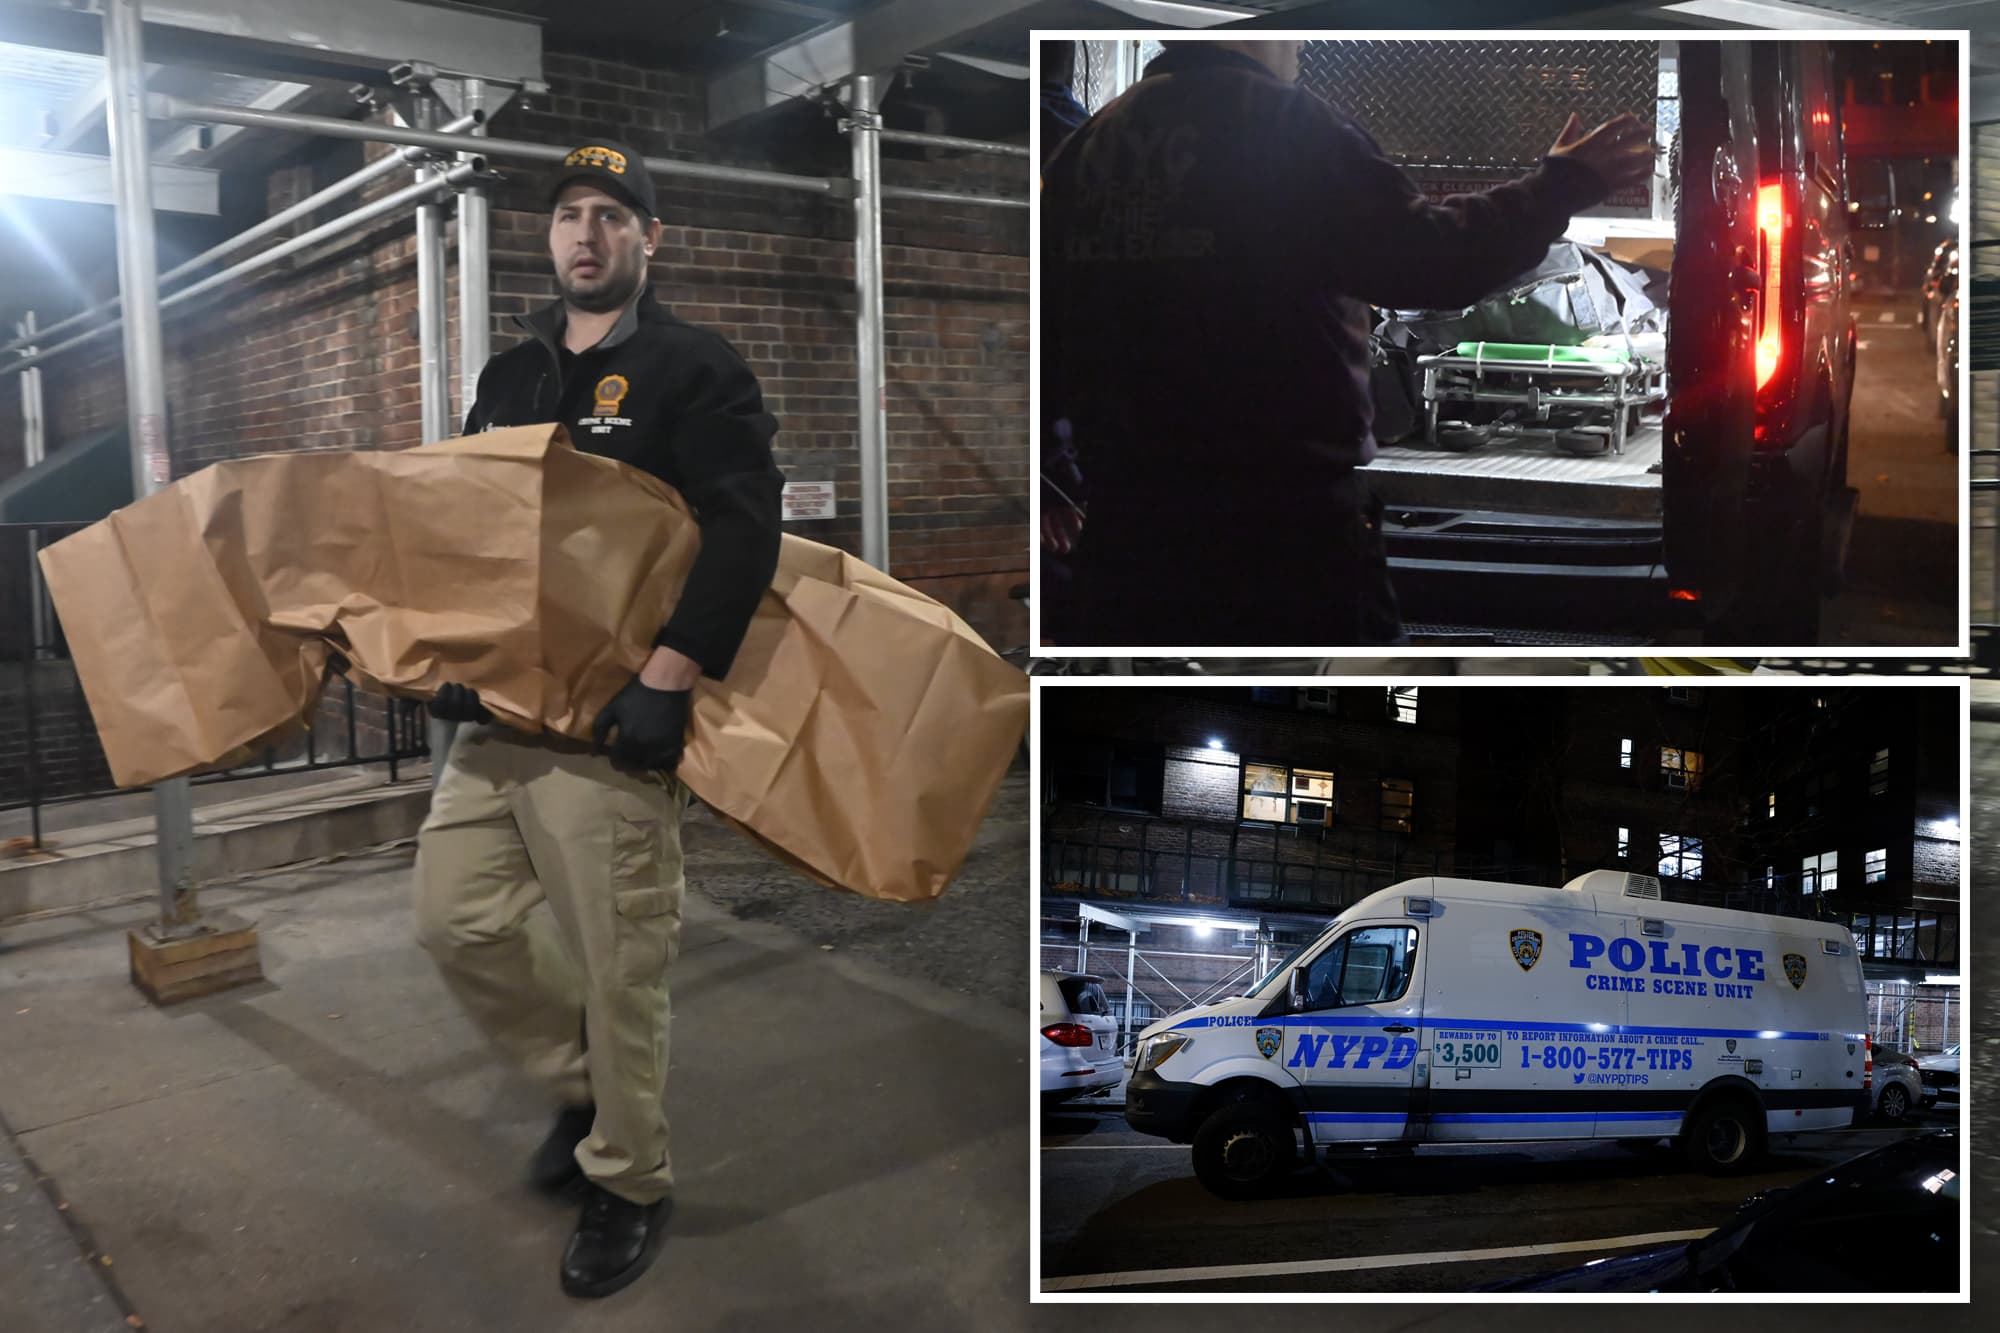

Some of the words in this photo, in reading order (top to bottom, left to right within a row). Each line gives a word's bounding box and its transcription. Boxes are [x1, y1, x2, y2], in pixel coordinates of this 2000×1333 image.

[1569, 933, 1765, 981] POLICE
[1586, 974, 1645, 992] CRIME
[1653, 979, 1707, 997] SCENE
[1715, 983, 1753, 999] UNIT
[1209, 1016, 1253, 1027] POLICE
[1439, 1031, 1473, 1040] REWARDS
[1476, 1032, 1485, 1040] UP
[1487, 1032, 1497, 1040] TO
[1507, 1031, 1519, 1040] TO
[1522, 1031, 1556, 1041] REPORT
[1559, 1032, 1616, 1043] INFORMATION
[1619, 1034, 1644, 1044] ABOUT
[1646, 1036, 1652, 1044] A
[1655, 1036, 1678, 1045] CRIME
[1287, 1034, 1418, 1070] NYPD
[1435, 1042, 1499, 1065] $3,500
[1521, 1045, 1693, 1070] 1-800-577-TIPS
[1587, 1073, 1649, 1085] @NYPDTIPS
